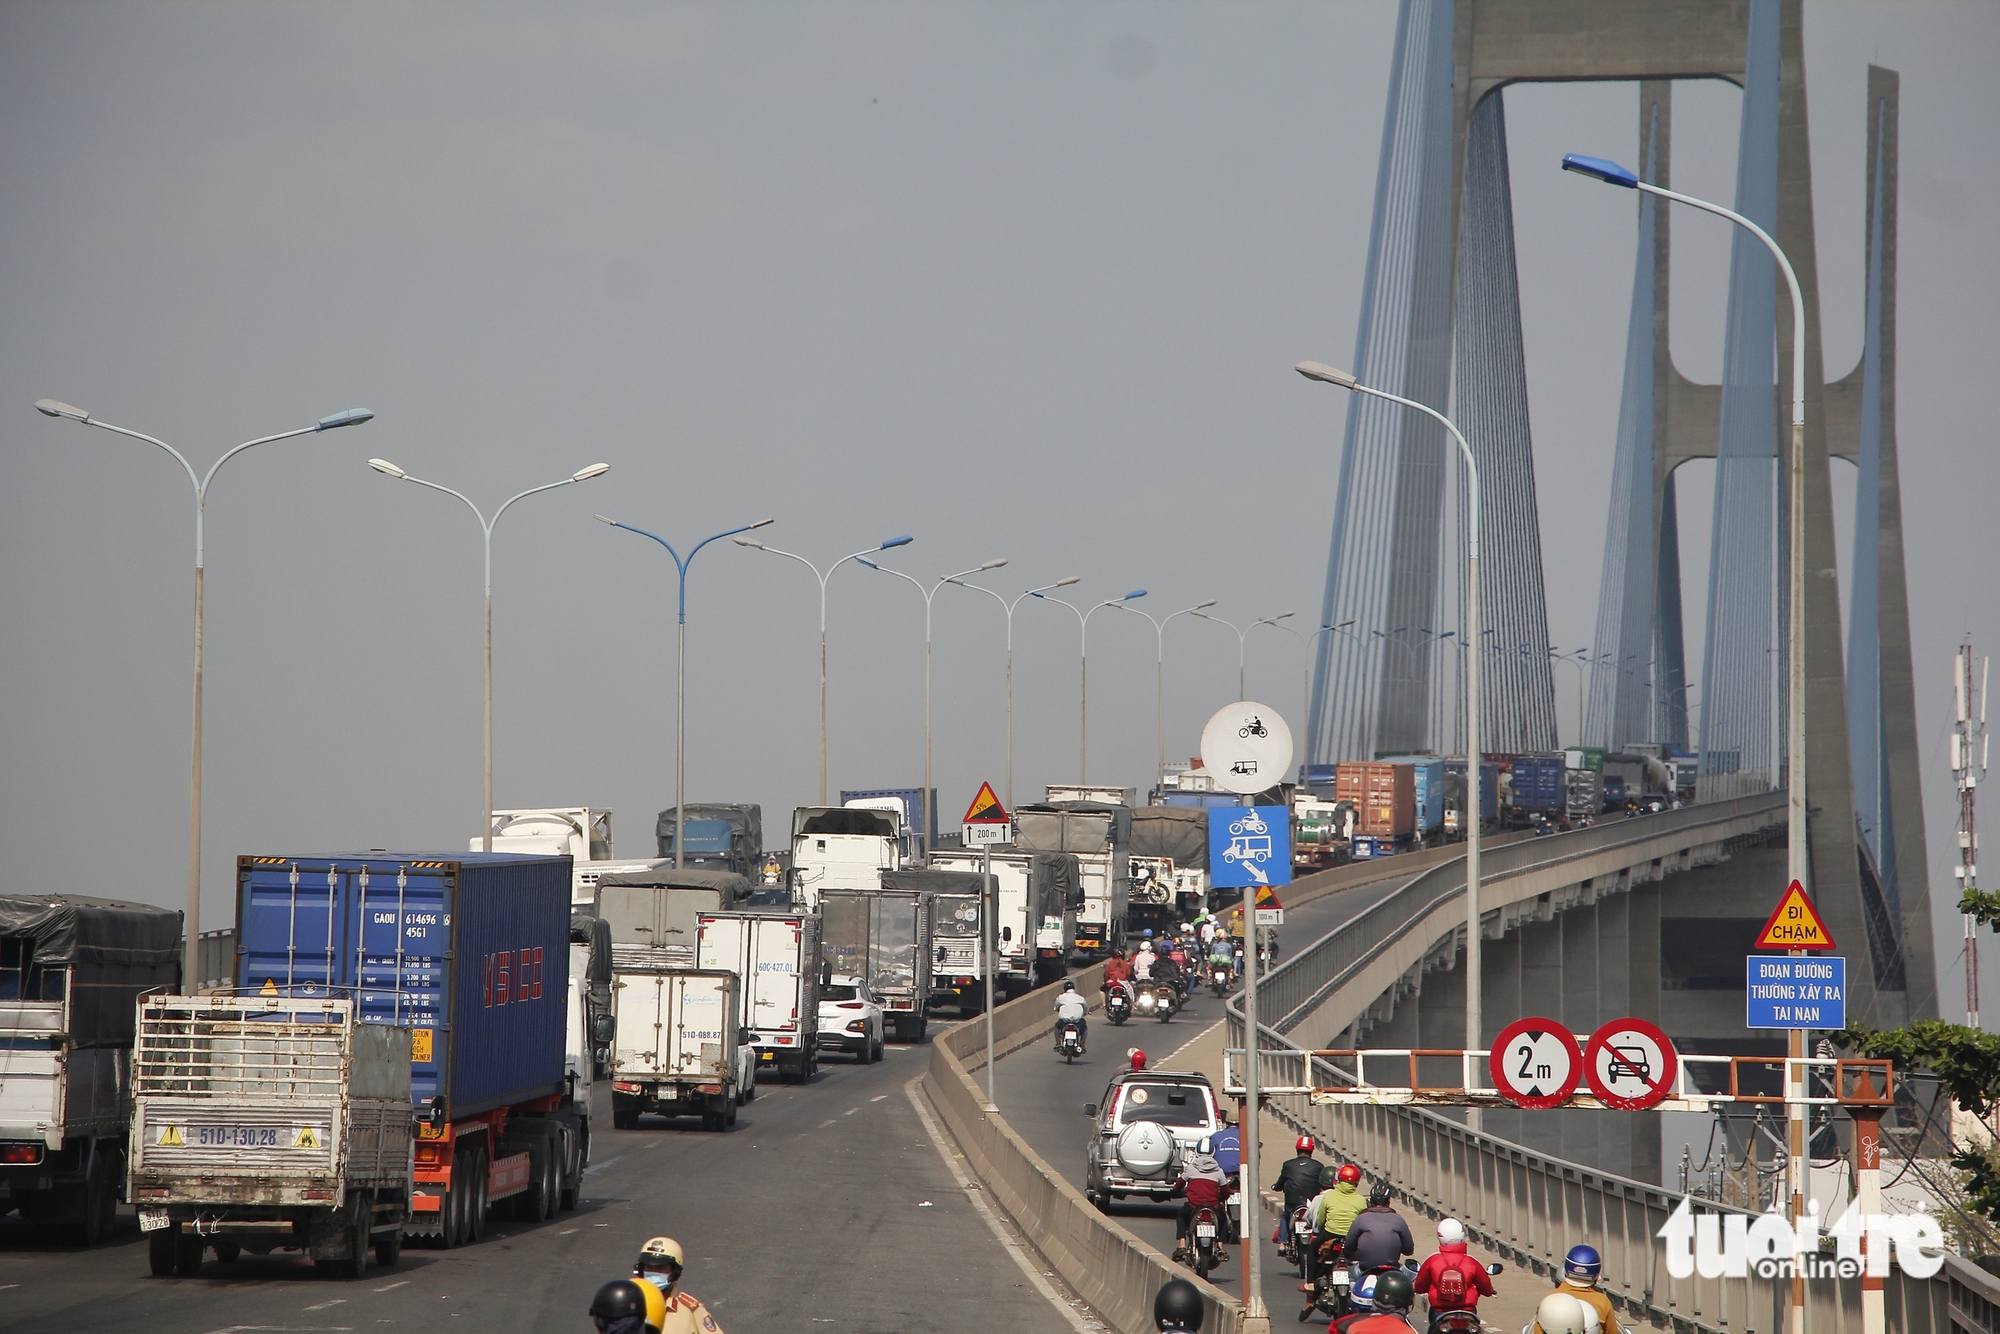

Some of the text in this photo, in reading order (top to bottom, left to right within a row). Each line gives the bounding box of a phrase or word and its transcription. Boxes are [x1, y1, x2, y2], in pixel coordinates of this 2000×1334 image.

[977, 829, 990, 838] 200
[374, 913, 396, 924] GAOU
[405, 914, 437, 925] 614696
[1787, 906, 1803, 919] ĐI
[405, 927, 427, 938] 45G1
[1772, 923, 1817, 942] CHẬM
[758, 962, 793, 972] 60C-427.01
[1759, 961, 1833, 981] ĐOẠN ĐƯỜNG
[1751, 982, 1841, 1001] THƯỜNG XẢY RA
[1773, 1006, 1820, 1024] TAI NẠN
[1518, 1045, 1551, 1079] 2 m
[200, 1128, 277, 1146] 51D-130.28
